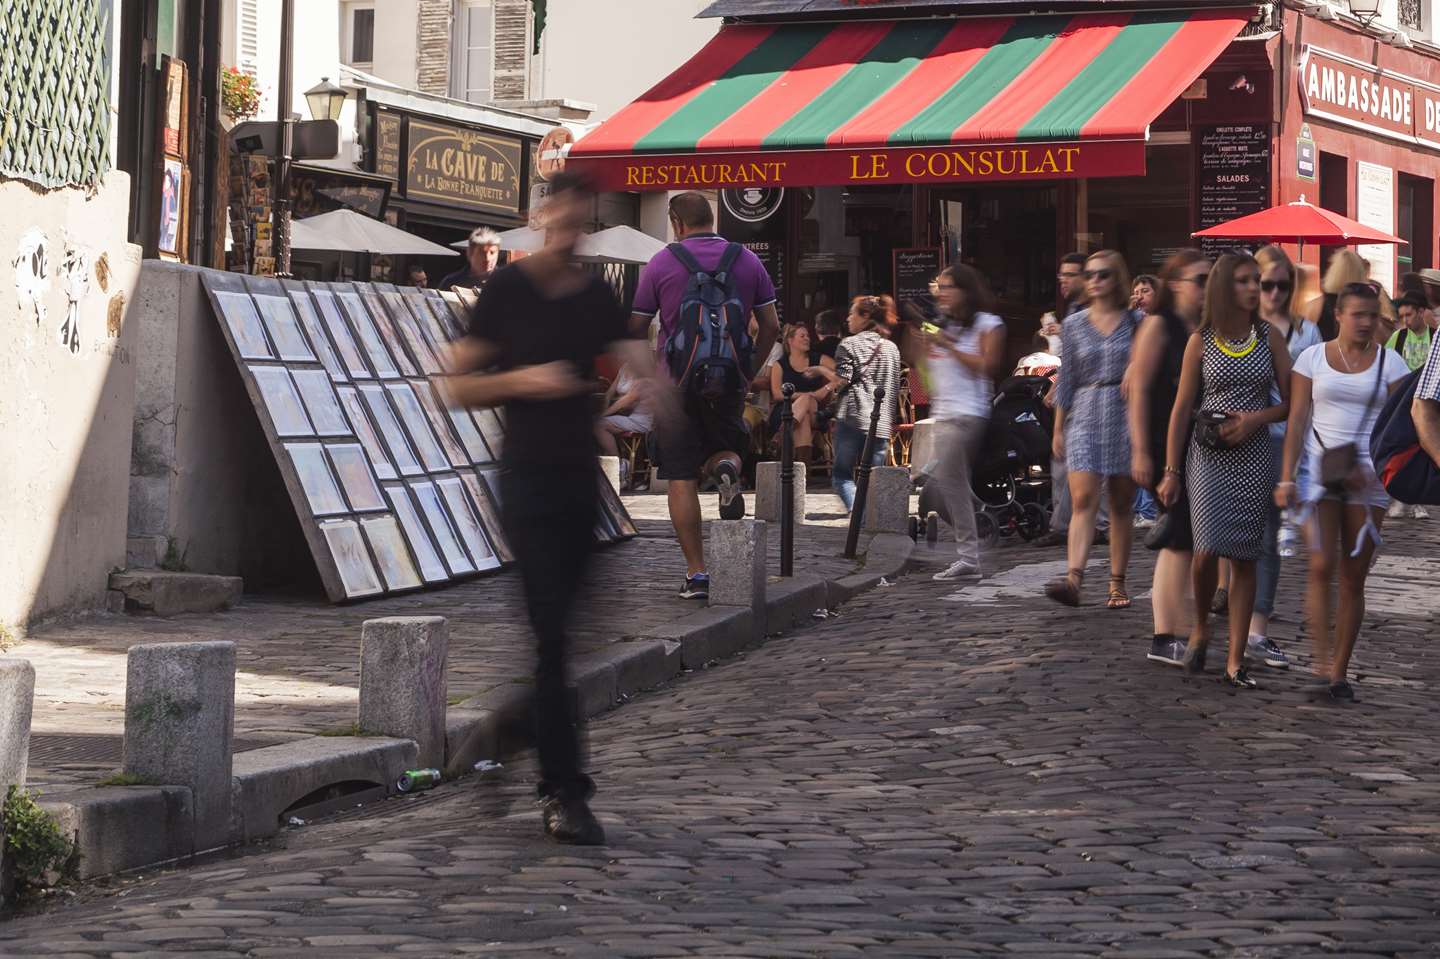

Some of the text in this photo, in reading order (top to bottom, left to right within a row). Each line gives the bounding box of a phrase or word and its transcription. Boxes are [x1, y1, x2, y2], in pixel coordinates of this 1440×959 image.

[1308, 63, 1411, 125] AMBASSADE
[425, 148, 505, 183] LA CAVE DE
[625, 148, 1080, 185] RESTAURANT LE CONSULAT
[424, 174, 503, 200] LA BONNE FRANQUETTE
[742, 241, 769, 251] NTRÉES
